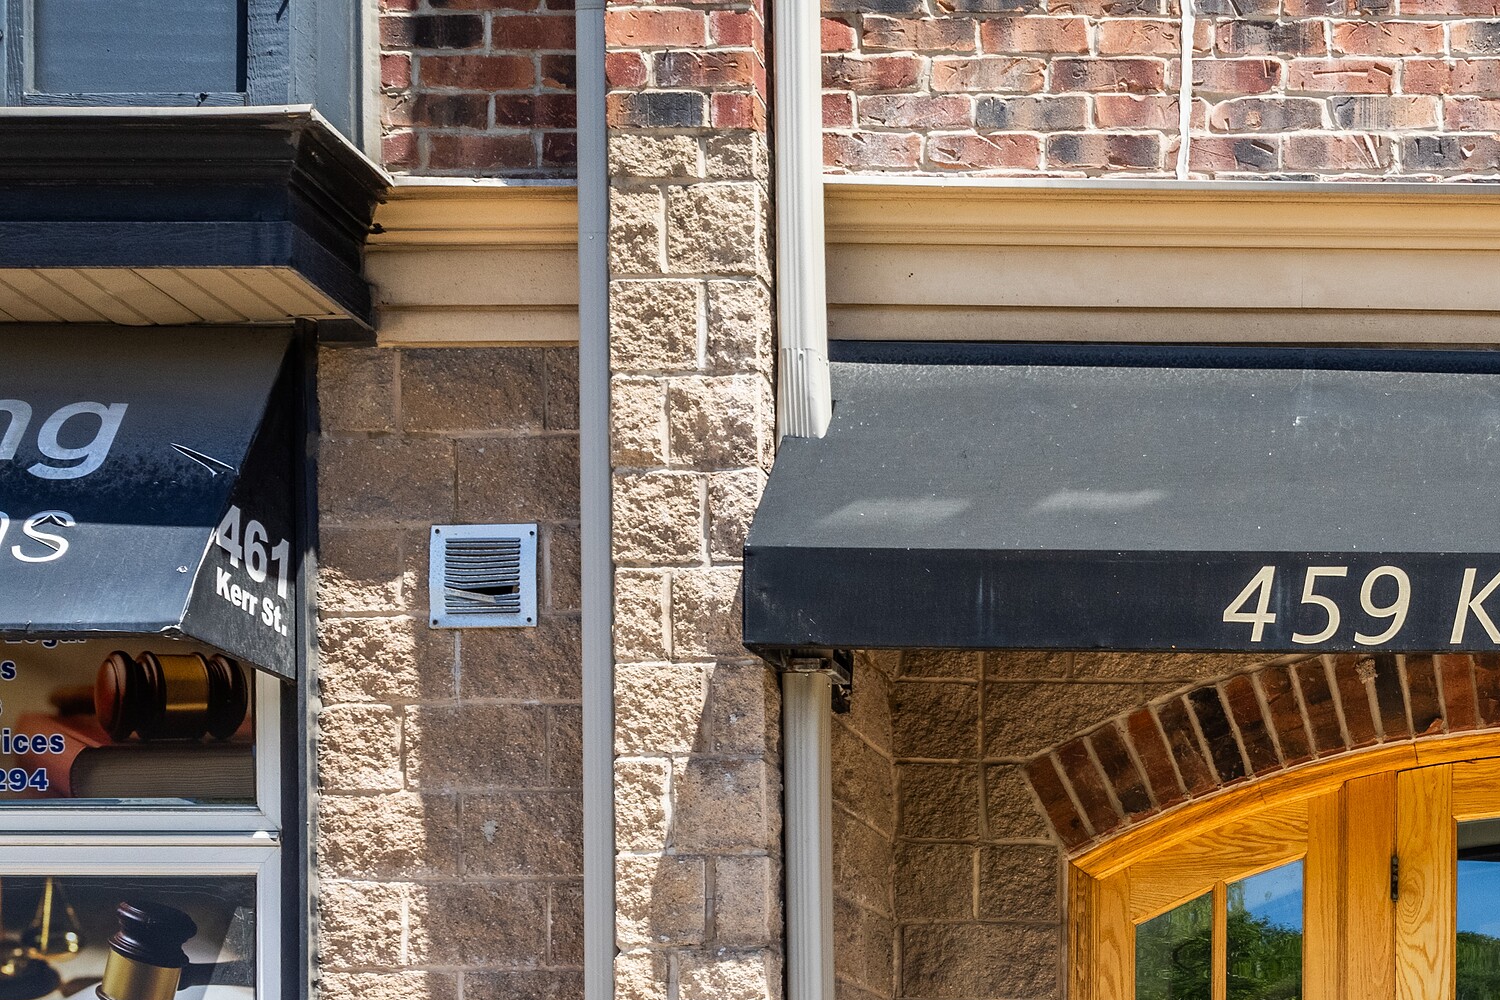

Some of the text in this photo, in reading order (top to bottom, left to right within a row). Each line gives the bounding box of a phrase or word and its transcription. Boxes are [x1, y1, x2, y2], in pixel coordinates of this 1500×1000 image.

[0, 509, 76, 562] s
[215, 504, 290, 600] 461
[216, 566, 287, 636] Kerr St.
[1223, 565, 1412, 648] 459
[0, 728, 65, 754] ices
